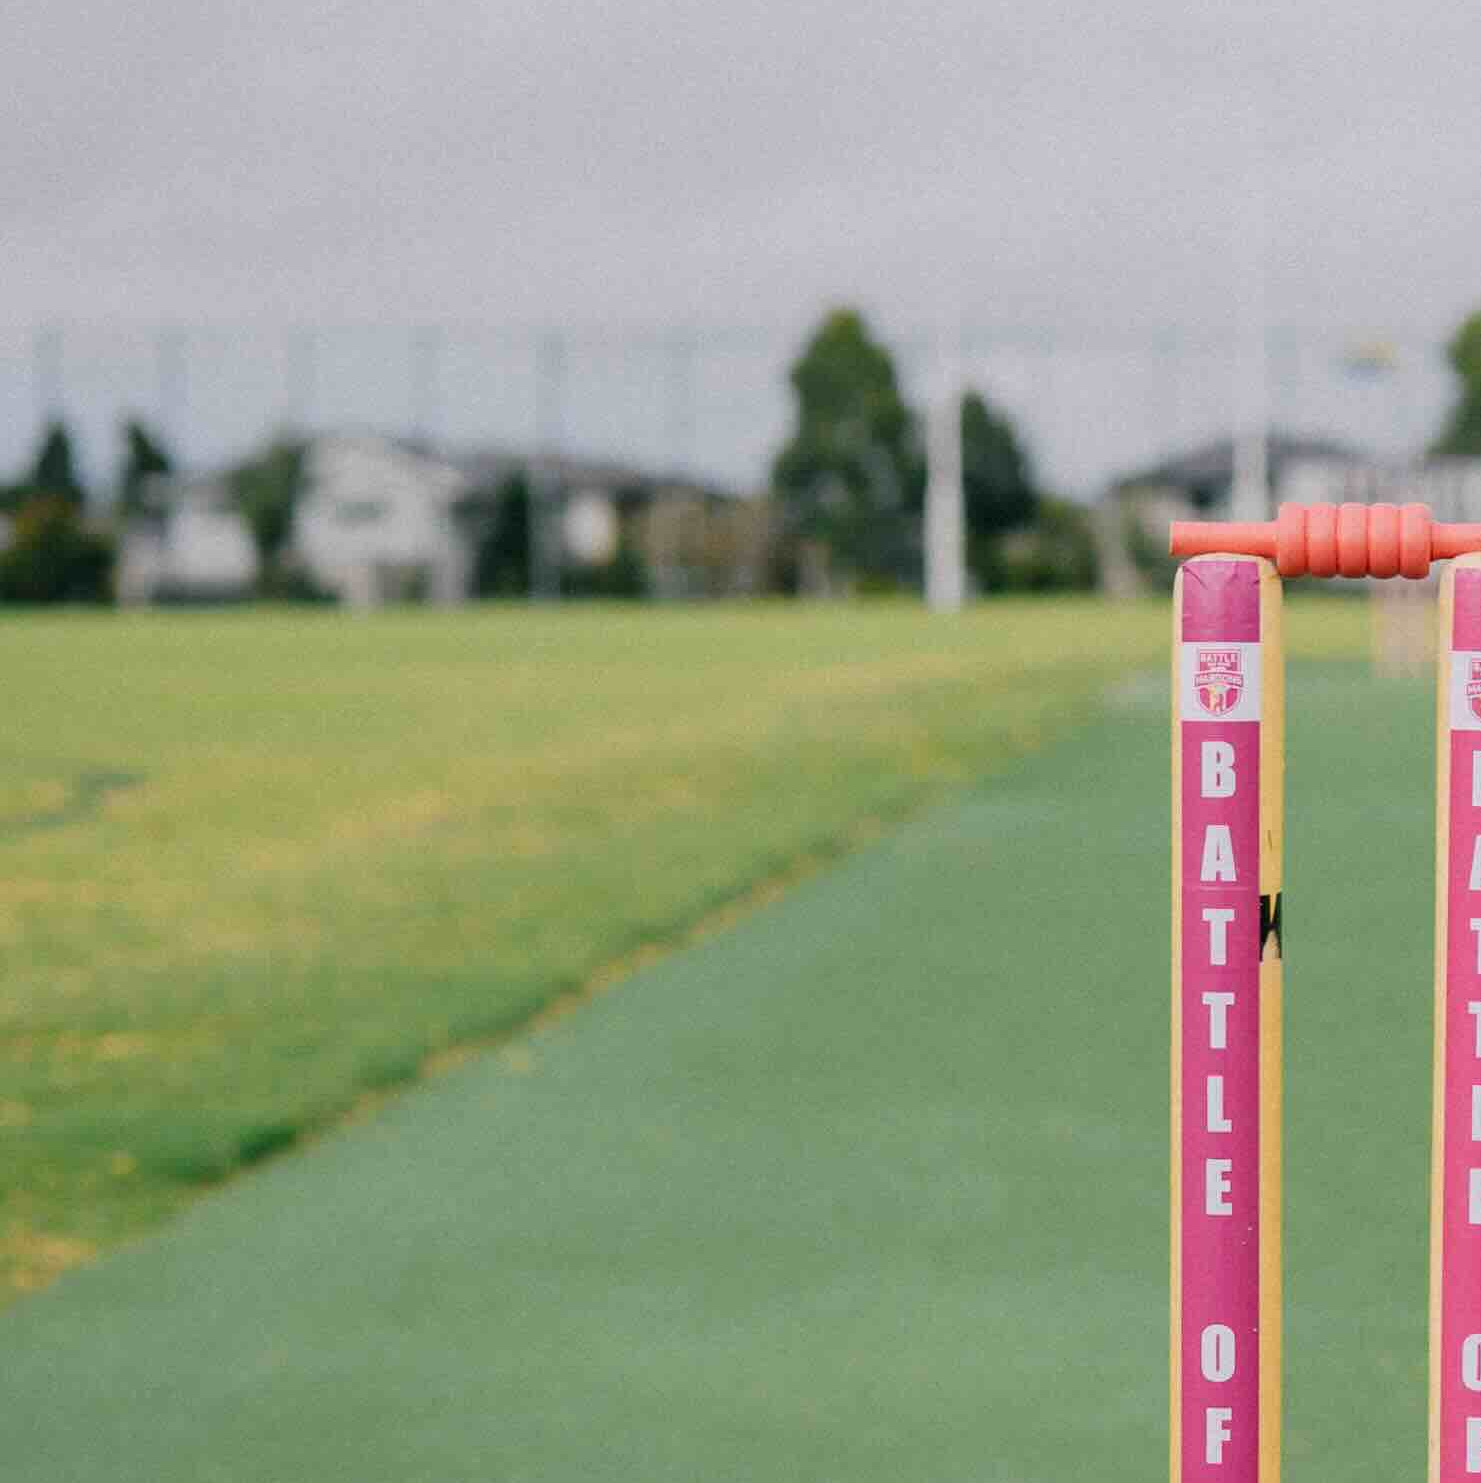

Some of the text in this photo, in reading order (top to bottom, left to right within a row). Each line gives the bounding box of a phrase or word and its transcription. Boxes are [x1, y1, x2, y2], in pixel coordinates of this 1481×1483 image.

[1200, 652, 1238, 663] BATTLE
[1201, 741, 1236, 1216] BATTLE
[1201, 1324, 1236, 1464] OF
